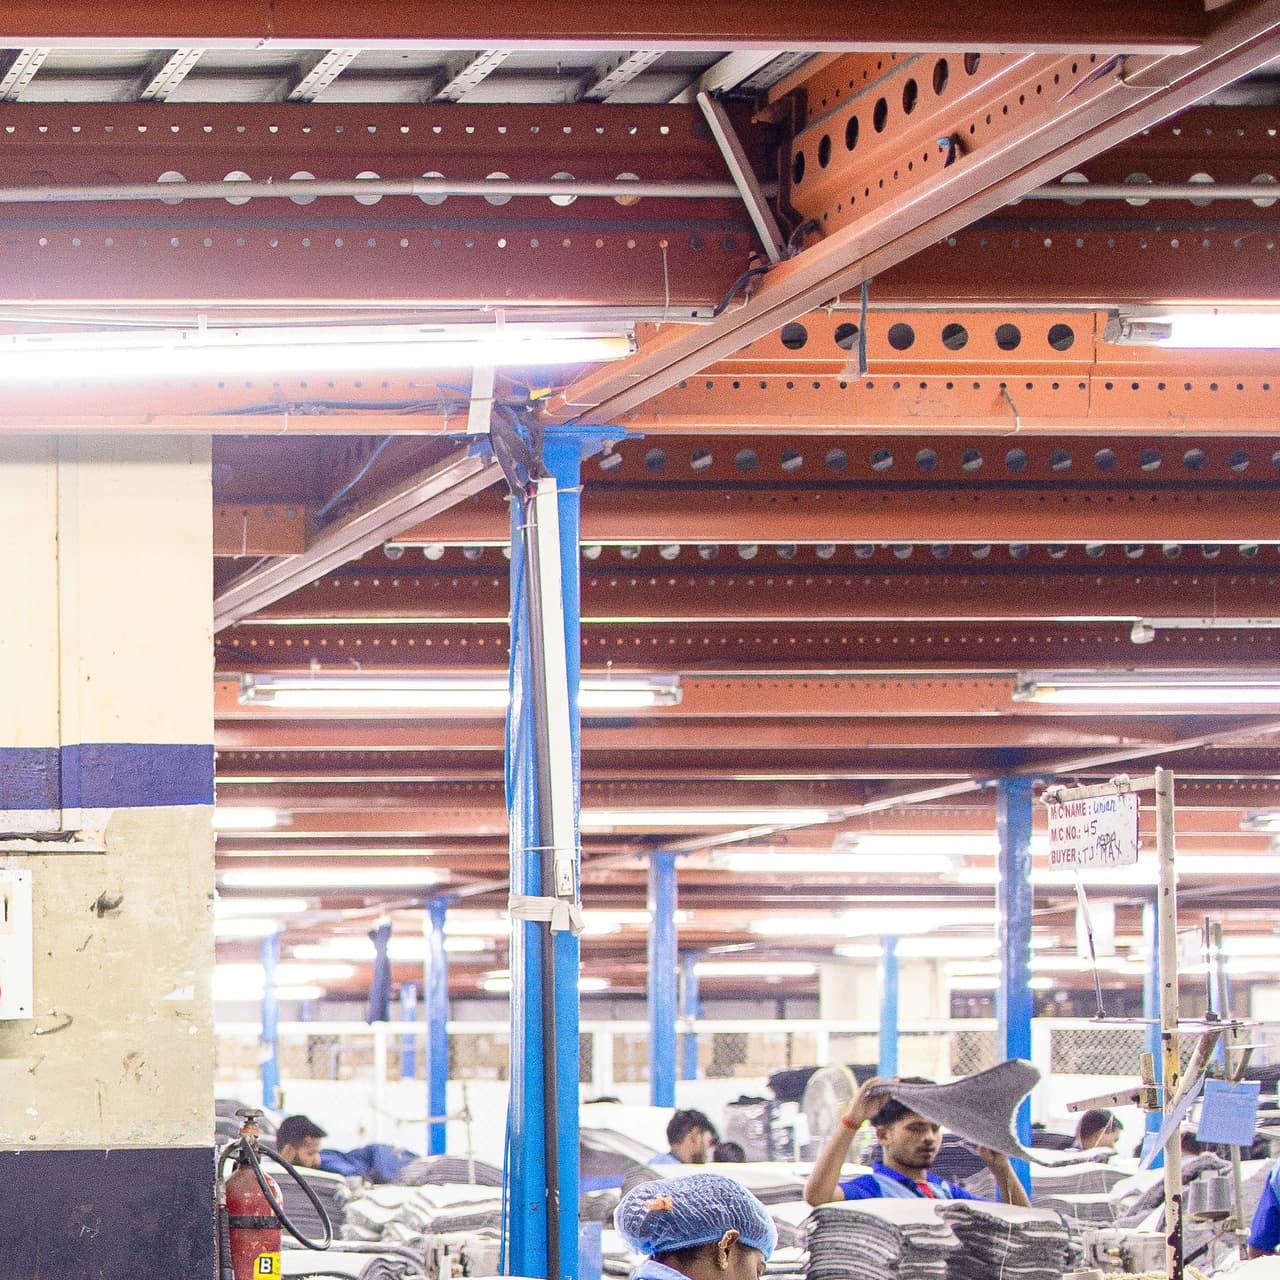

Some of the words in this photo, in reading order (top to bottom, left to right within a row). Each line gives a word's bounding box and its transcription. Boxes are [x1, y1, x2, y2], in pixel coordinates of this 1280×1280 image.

[1083, 819, 1098, 838] 45
[1051, 848, 1076, 864] BUYER
[260, 1257, 272, 1273] B
